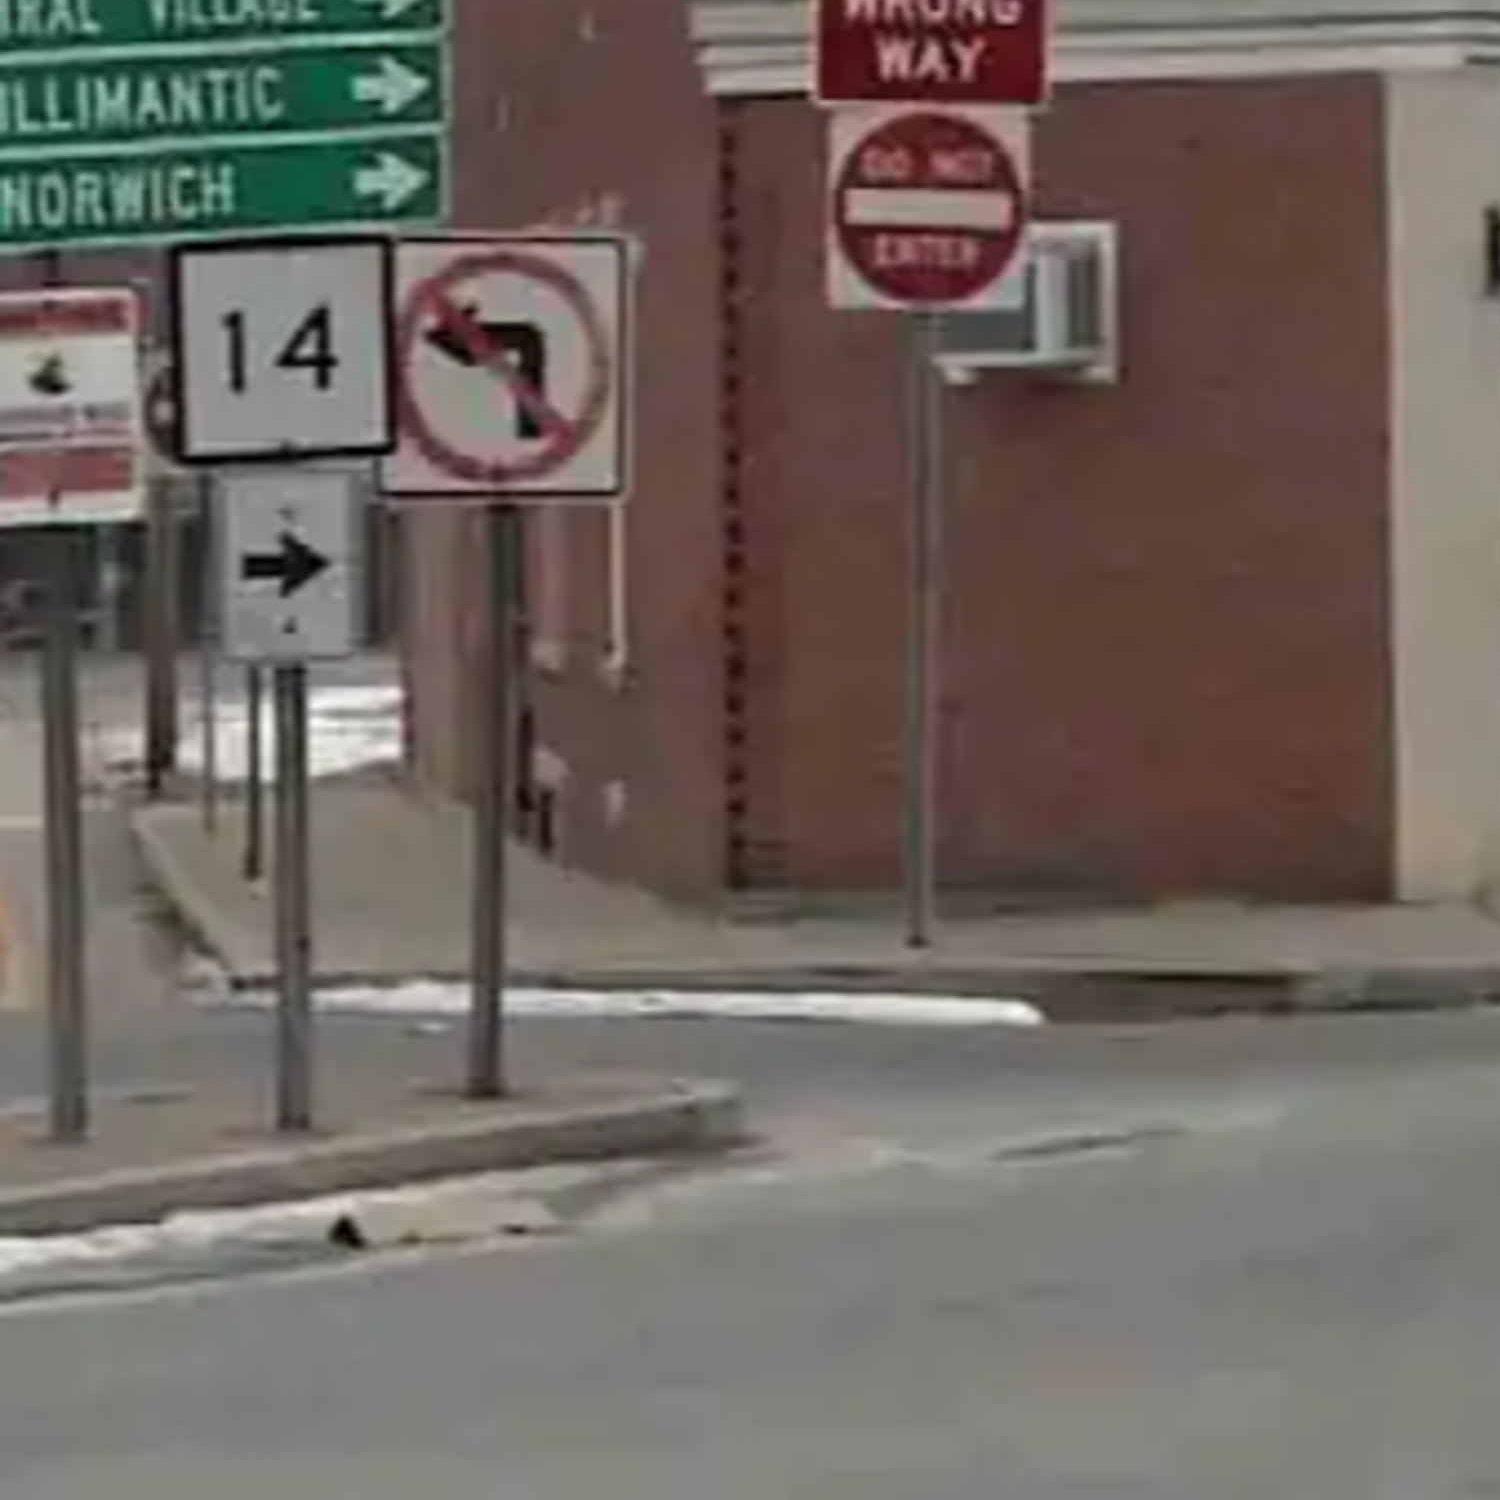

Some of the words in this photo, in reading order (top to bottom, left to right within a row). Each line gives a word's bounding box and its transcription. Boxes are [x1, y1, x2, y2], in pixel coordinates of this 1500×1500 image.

[875, 35, 987, 83] WAY
[860, 145, 913, 181] DO
[929, 149, 995, 183] NOT
[0, 162, 236, 228] NORWICH
[873, 232, 980, 271] ENTER
[221, 305, 340, 394] 14
